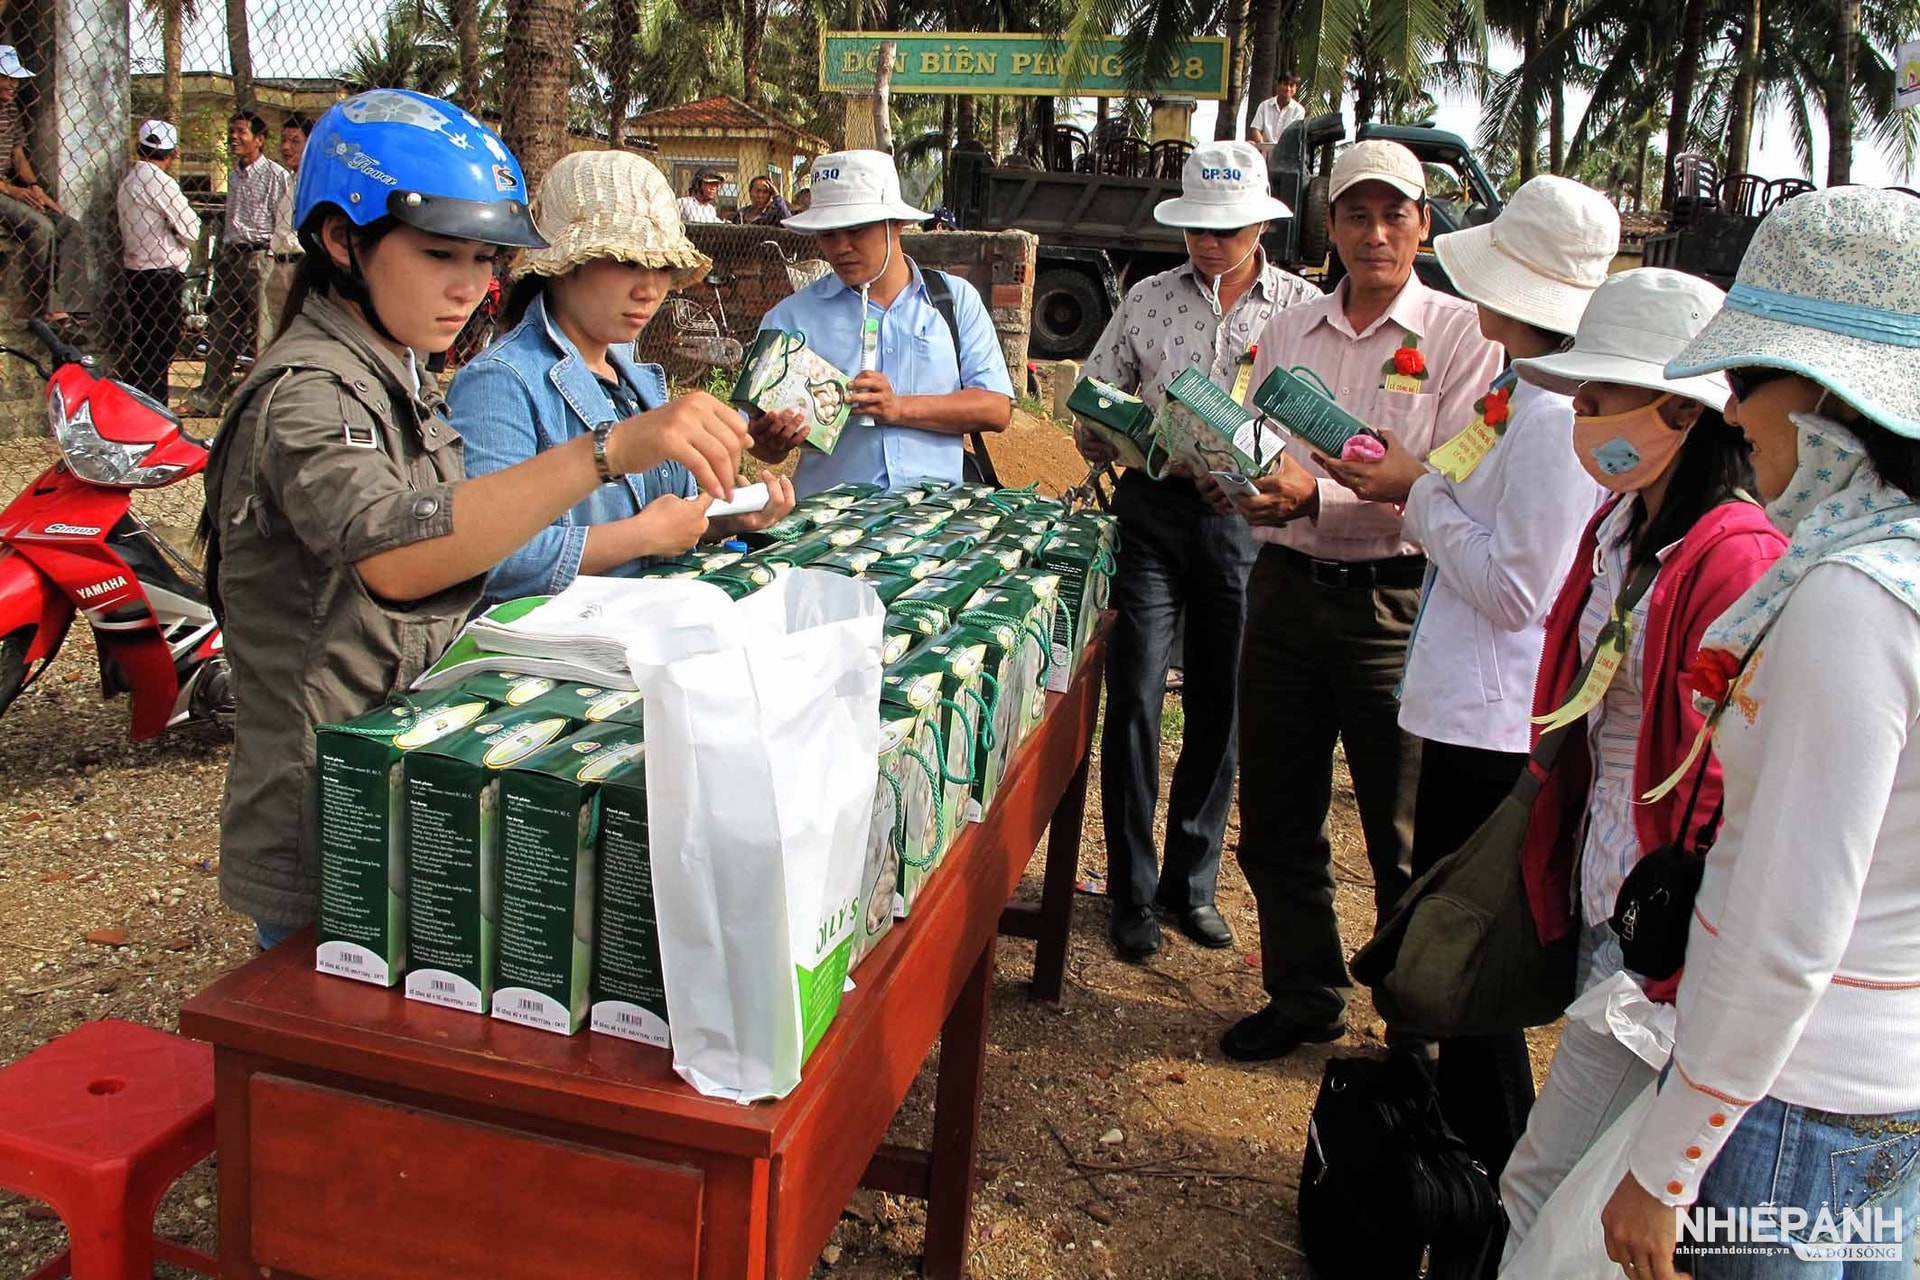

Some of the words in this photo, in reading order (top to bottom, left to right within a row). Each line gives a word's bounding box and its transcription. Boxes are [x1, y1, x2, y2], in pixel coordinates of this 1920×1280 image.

[920, 44, 998, 75] BIÊN
[348, 152, 398, 186] Flower
[76, 575, 128, 599] YAMAHA
